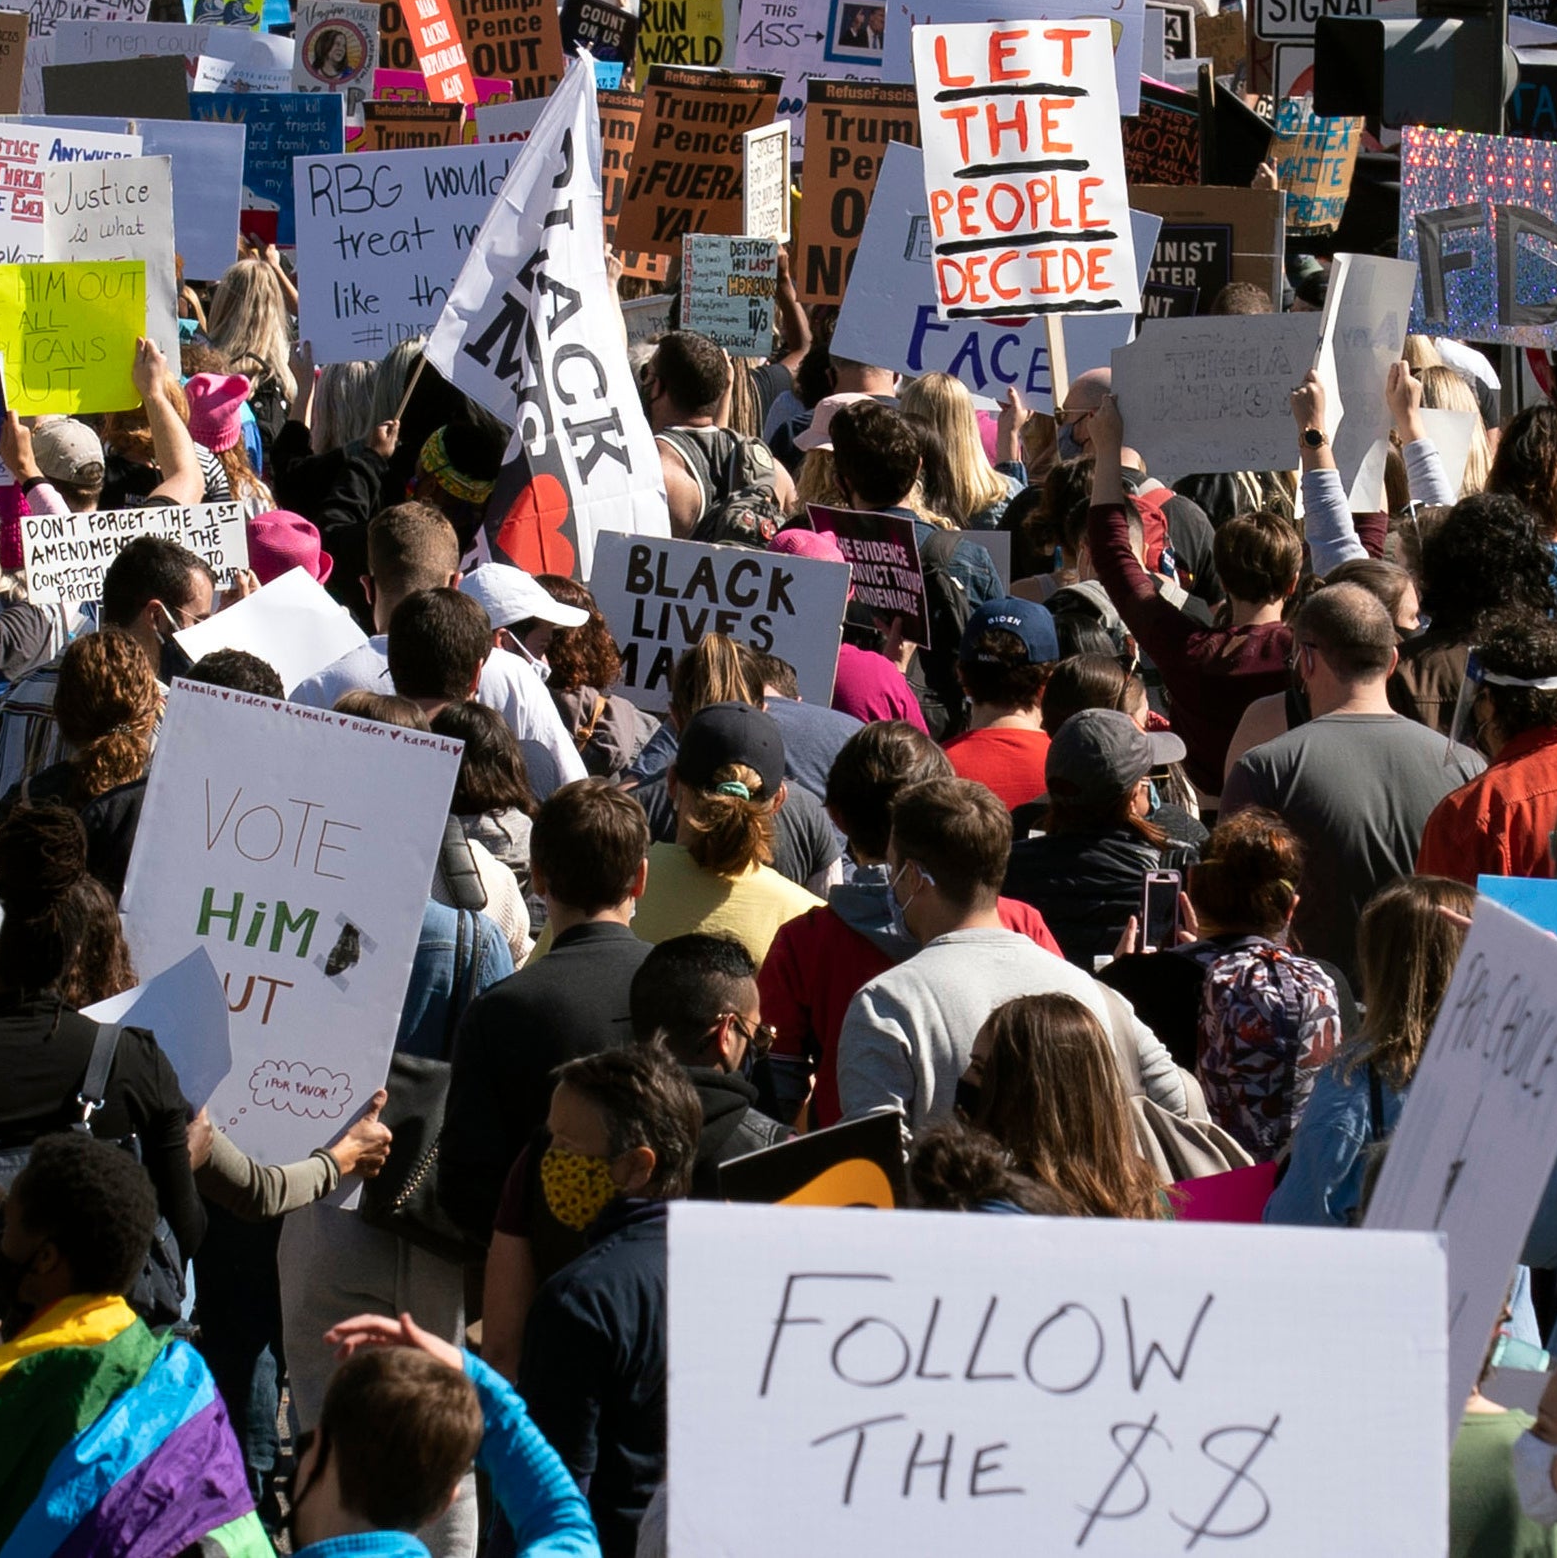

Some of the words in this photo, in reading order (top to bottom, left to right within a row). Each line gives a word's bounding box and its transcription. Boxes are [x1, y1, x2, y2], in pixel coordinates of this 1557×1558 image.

[580, 5, 626, 32] COUNT
[642, 1, 687, 32] RUN
[760, 3, 796, 18] THIS
[422, 22, 451, 48] RACISM
[577, 22, 598, 38] ON
[601, 29, 620, 46] US
[642, 35, 721, 65] WORLD
[743, 23, 803, 47] ASS
[419, 43, 467, 78] DEPLORABLE
[934, 28, 1091, 87] LET
[441, 75, 466, 101] AGAIN
[664, 69, 766, 90] RefuseFascism.org
[654, 90, 759, 125] Trump/
[652, 123, 741, 154] Pence
[940, 98, 1075, 165] THE
[53, 170, 150, 215] Justice
[309, 163, 402, 217] RBG
[628, 159, 742, 201] ¡FUERA
[651, 205, 708, 242] YA!
[930, 175, 1111, 237] PEOPLE
[69, 223, 88, 244] is
[100, 221, 145, 238] what
[334, 217, 435, 260] treat
[937, 248, 1117, 305] DECIDE
[333, 275, 380, 319] like
[625, 544, 796, 616] BLACK
[632, 605, 776, 653] LIVES
[206, 778, 362, 880] VOTE
[296, 1079, 341, 1102] FAVOR!
[760, 1272, 1215, 1397] FOLLOW
[811, 1415, 1025, 1506] THE
[1074, 1413, 1280, 1551] $$
